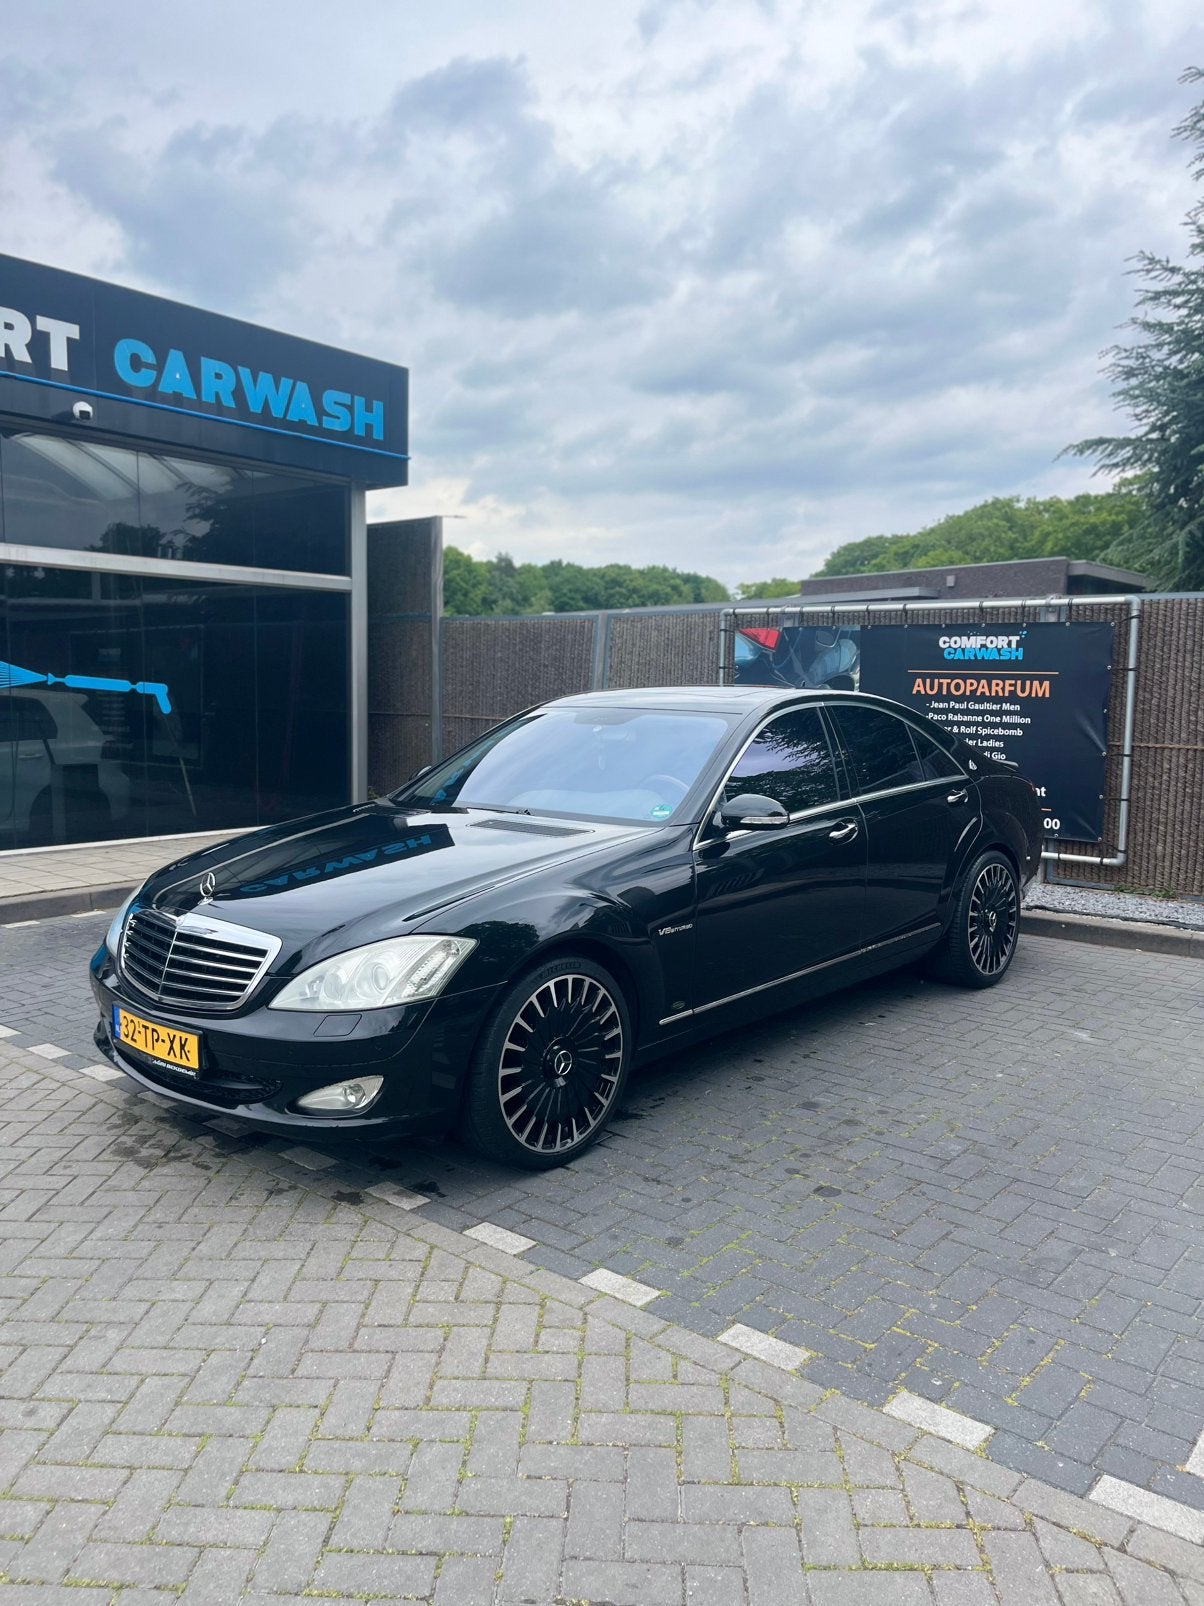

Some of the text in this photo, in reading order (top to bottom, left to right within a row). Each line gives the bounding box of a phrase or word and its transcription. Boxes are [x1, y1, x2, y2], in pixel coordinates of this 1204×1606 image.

[114, 338, 385, 441] CARWASH
[938, 635, 1020, 648] COMFORT
[943, 647, 1024, 660] CARWASH
[911, 678, 1051, 698] AUTOPARFUM
[930, 701, 949, 709] Jean
[968, 702, 1001, 710] Gaultier
[1001, 703, 1020, 711] Men
[947, 713, 983, 722] Rabanne
[984, 714, 1001, 723] One
[1002, 715, 1031, 724] Million
[952, 725, 959, 733] &
[960, 725, 976, 734] Rolf
[977, 726, 1023, 736] Spicebomb
[978, 738, 1004, 748] Ladies
[991, 751, 1006, 760] Gio
[123, 1015, 191, 1062] 32-TP-XK
